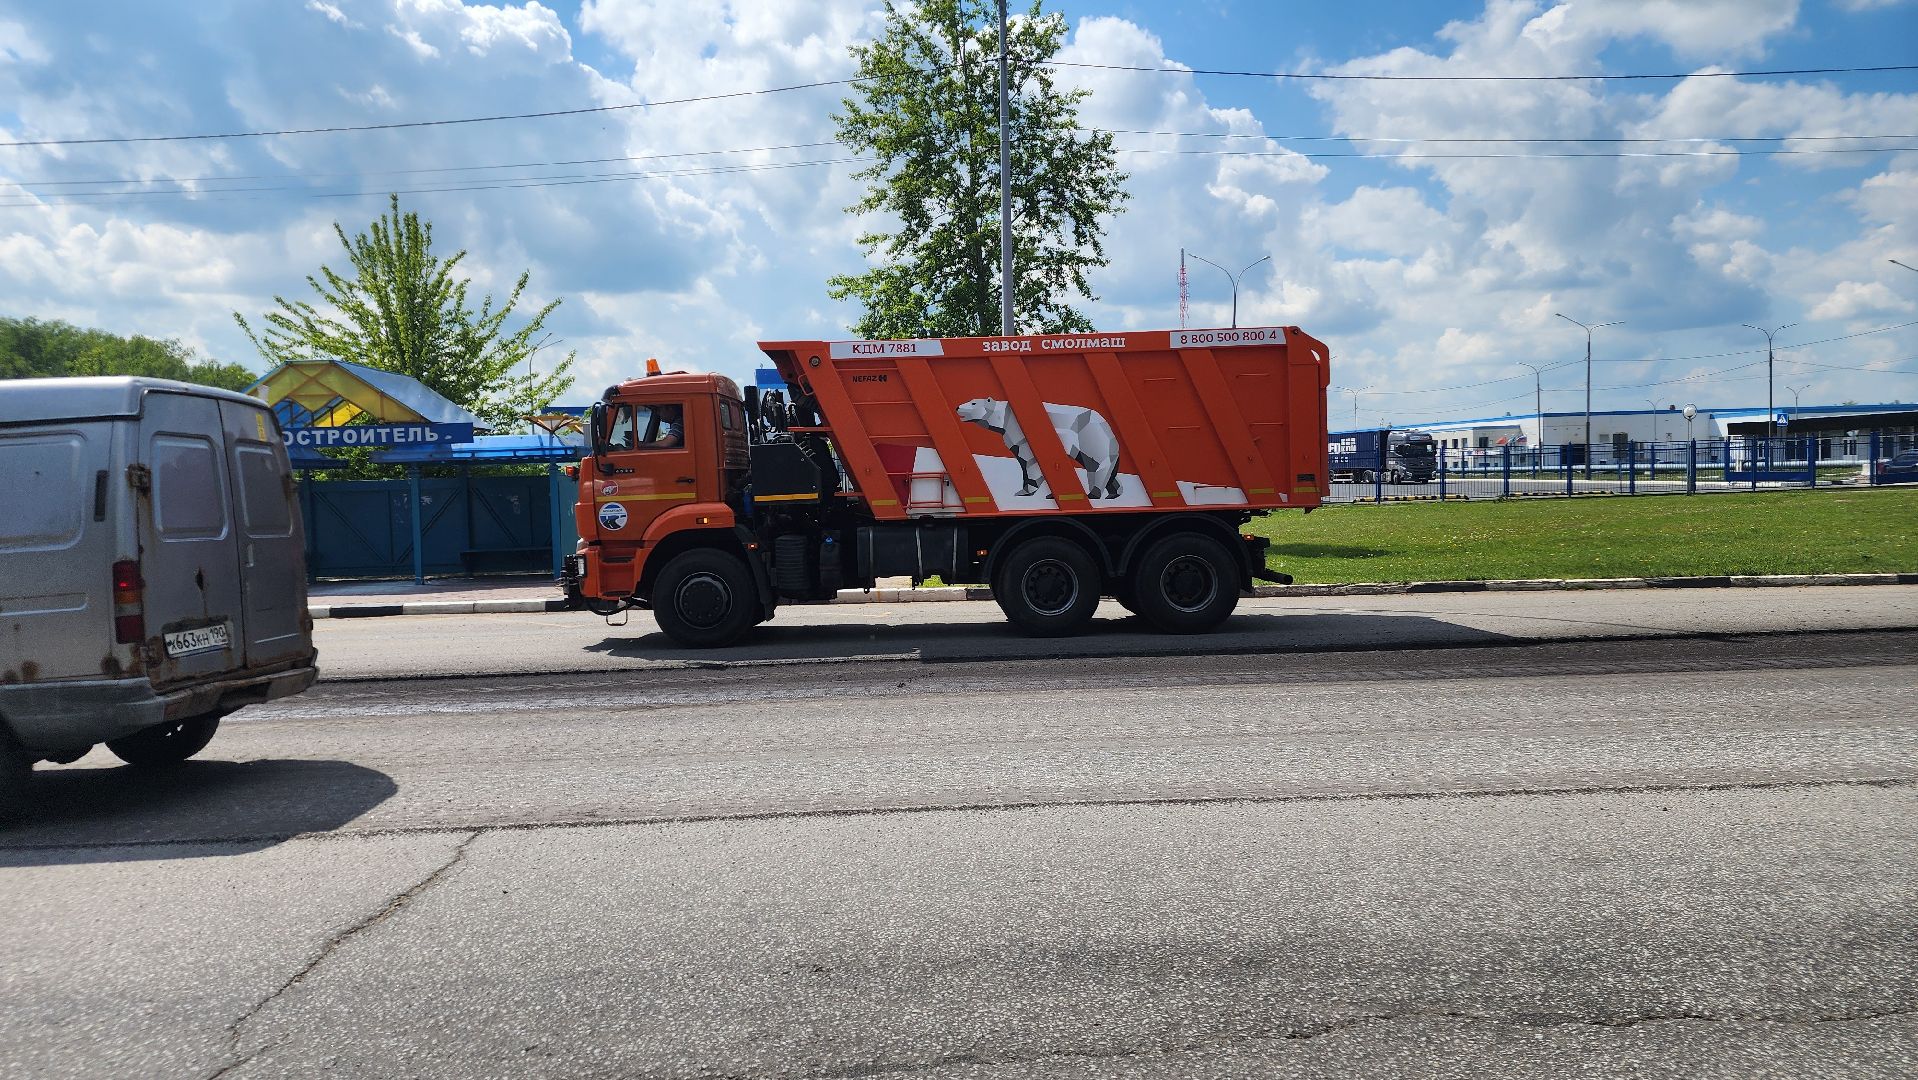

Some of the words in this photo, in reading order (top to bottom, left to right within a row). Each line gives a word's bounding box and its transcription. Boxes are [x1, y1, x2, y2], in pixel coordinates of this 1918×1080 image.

[1180, 334, 1188, 344] 8
[1191, 333, 1214, 344] 800
[1217, 332, 1240, 342] 500
[1242, 330, 1265, 341] 800
[1269, 330, 1277, 340] 4
[852, 344, 885, 354] КДМ
[888, 343, 917, 353] 7881
[982, 340, 1032, 352] завод
[852, 375, 878, 383] NEFAZ
